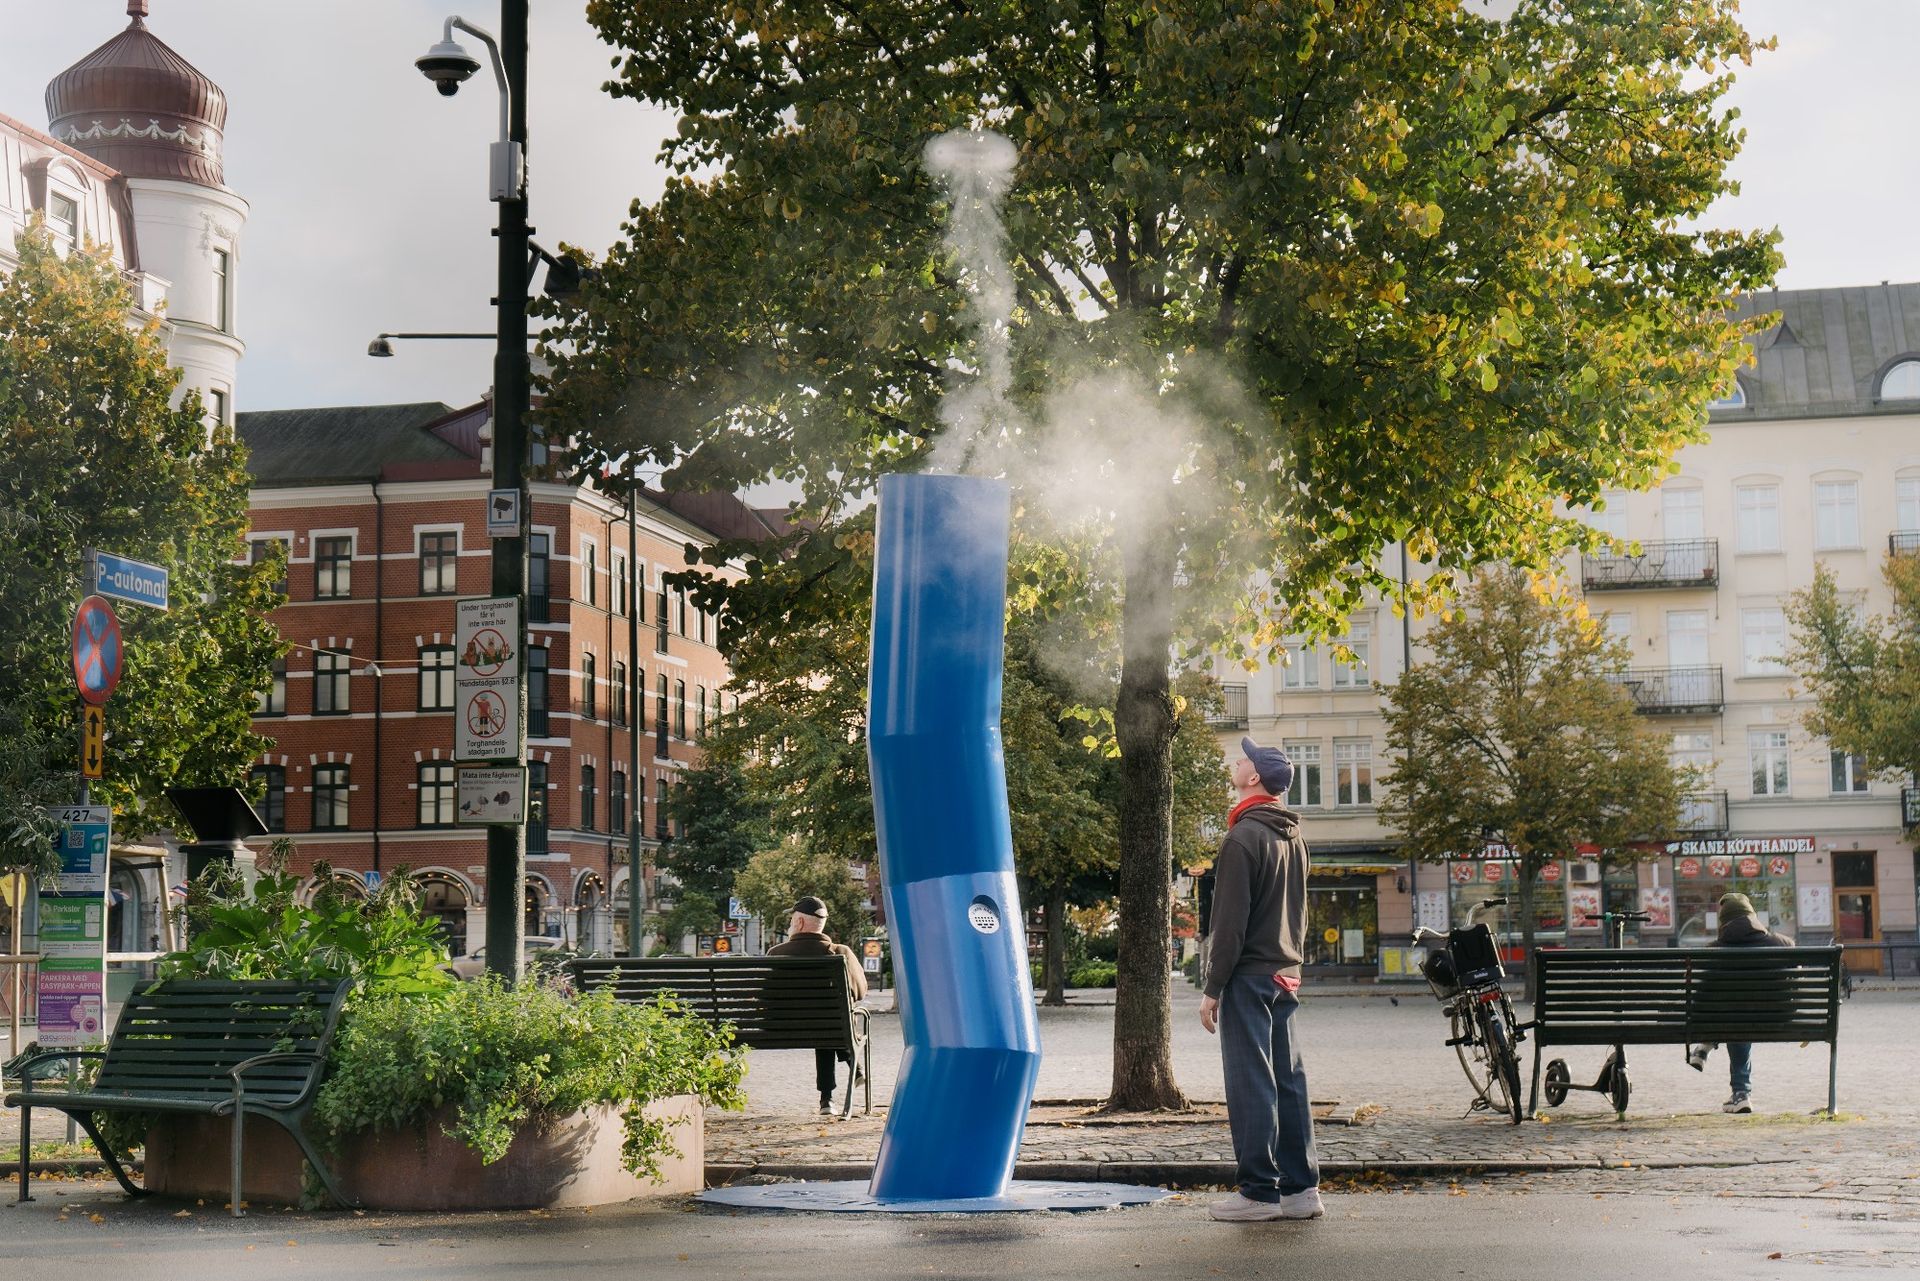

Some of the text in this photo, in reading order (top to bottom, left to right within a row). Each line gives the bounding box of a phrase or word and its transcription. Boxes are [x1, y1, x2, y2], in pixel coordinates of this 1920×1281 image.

[98, 562, 166, 599] P-automat
[481, 601, 514, 611] torghandel
[466, 739, 508, 748] Torghandels-
[468, 748, 493, 756] stadgan
[462, 771, 520, 779] Mata inte fåglarna!
[62, 810, 90, 821] 427
[53, 904, 81, 913] Parkster
[40, 982, 101, 990] EASYPARK-APPEN
